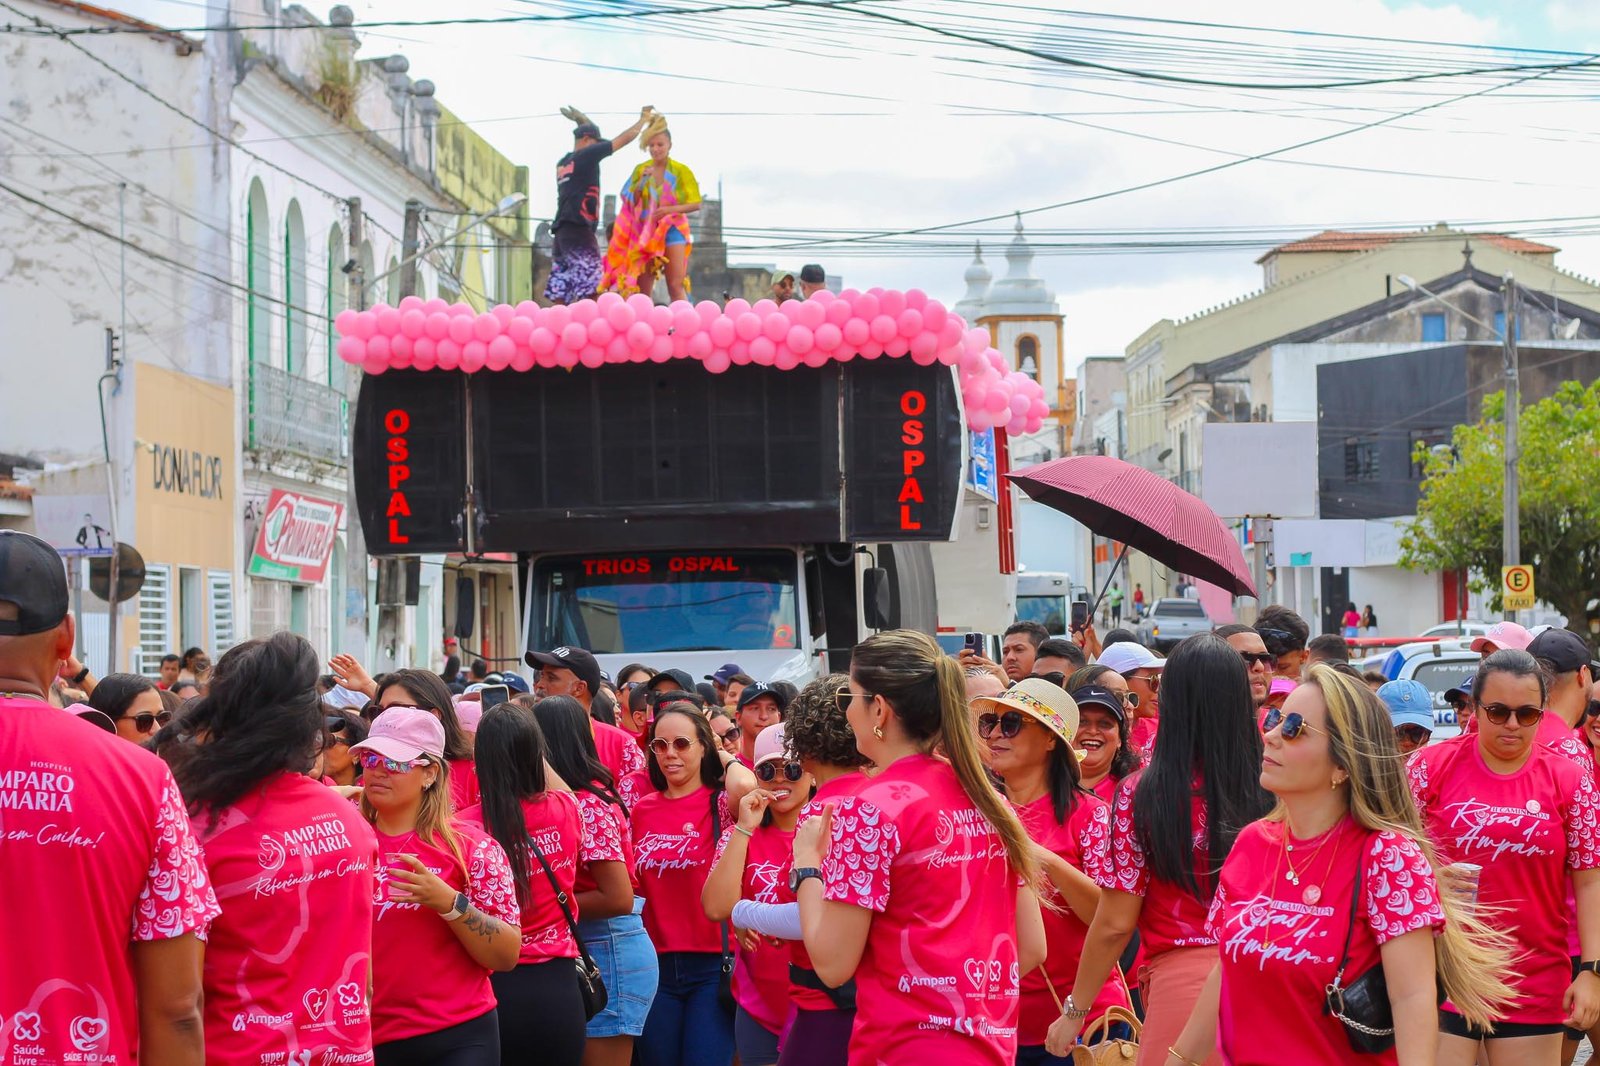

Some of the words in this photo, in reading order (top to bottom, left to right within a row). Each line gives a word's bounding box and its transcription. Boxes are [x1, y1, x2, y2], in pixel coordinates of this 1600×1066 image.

[898, 390, 926, 530] OSPAL
[153, 443, 191, 495] DONA
[192, 450, 222, 500] FLOR
[384, 409, 411, 544] OSPAL
[582, 557, 651, 576] TRIOS
[668, 556, 739, 572] OSPAL
[1513, 572, 1524, 587] E
[1510, 599, 1530, 608] TAXI
[30, 761, 73, 773] HOSPITAL
[0, 790, 73, 813] MARIA
[311, 812, 338, 821] HOSPITAL
[7, 829, 34, 841] em
[37, 823, 105, 849] Cuidar!
[284, 819, 346, 846] AMPARO
[303, 834, 353, 858] MARIA
[246, 873, 317, 900] Referência
[317, 869, 335, 879] em
[337, 855, 371, 877] Cuidar!
[911, 975, 957, 987] Amparo
[247, 1012, 293, 1026] Amparo
[343, 1007, 363, 1018] Saúde
[344, 1017, 361, 1026] Livre
[929, 1014, 952, 1027] super
[13, 1043, 46, 1056] Saúde
[13, 1055, 38, 1066] Livre
[83, 1053, 98, 1063] NO
[260, 1051, 286, 1065] super
